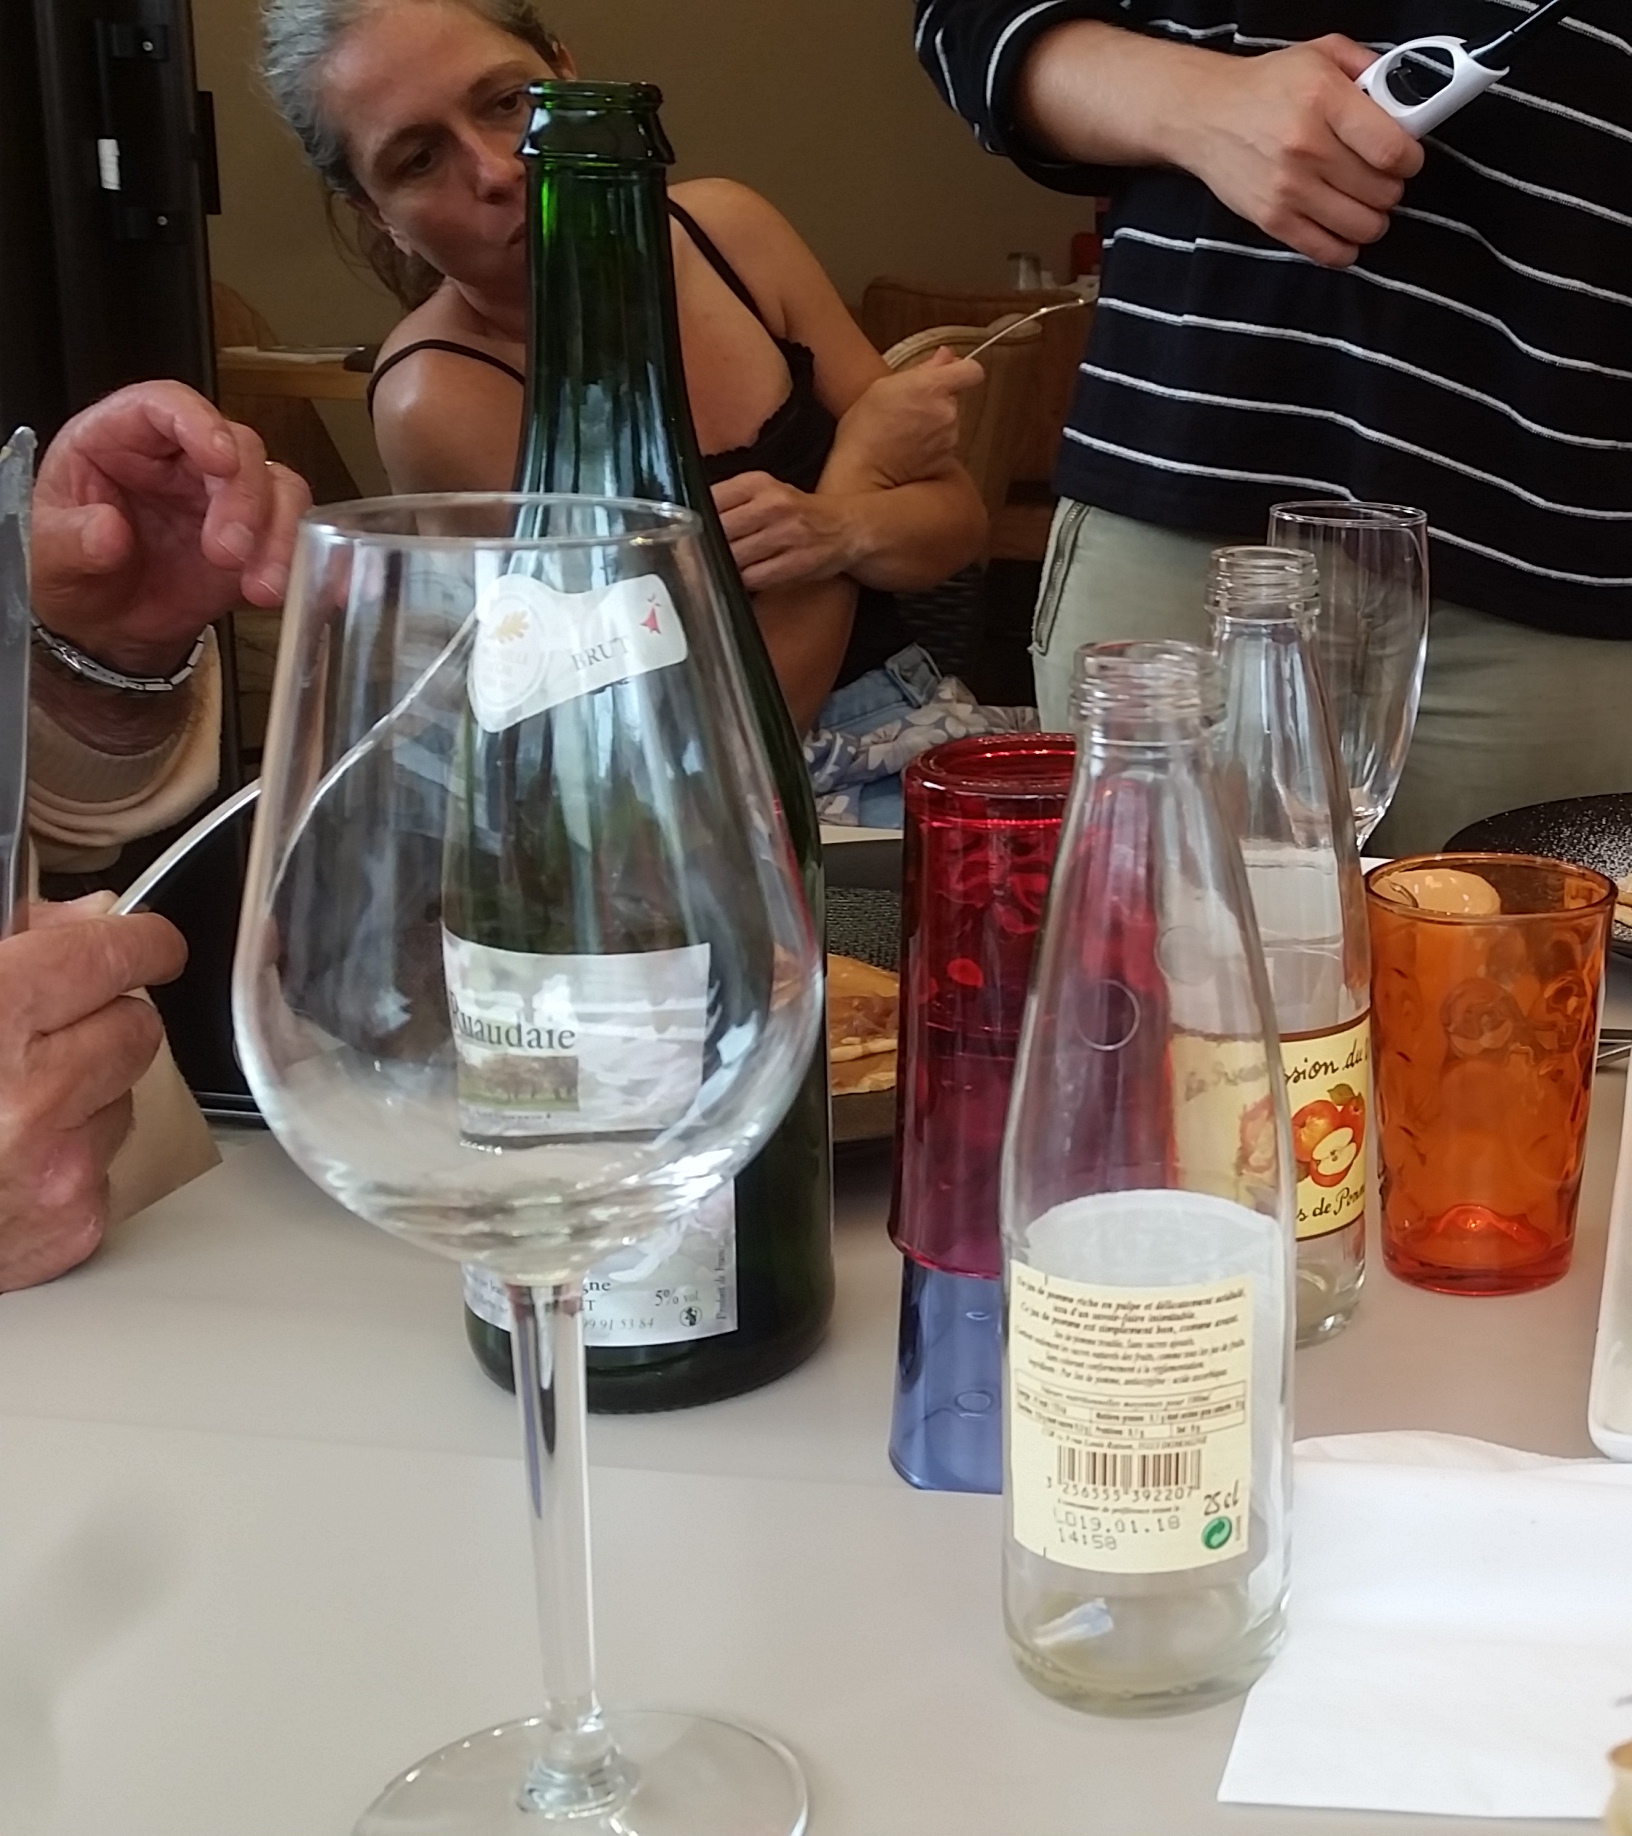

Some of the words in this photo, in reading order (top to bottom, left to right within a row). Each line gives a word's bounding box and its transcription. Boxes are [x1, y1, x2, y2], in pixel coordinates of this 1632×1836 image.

[571, 636, 629, 671] BRUT
[1312, 1197, 1332, 1217] de
[655, 1287, 679, 1306] 5%
